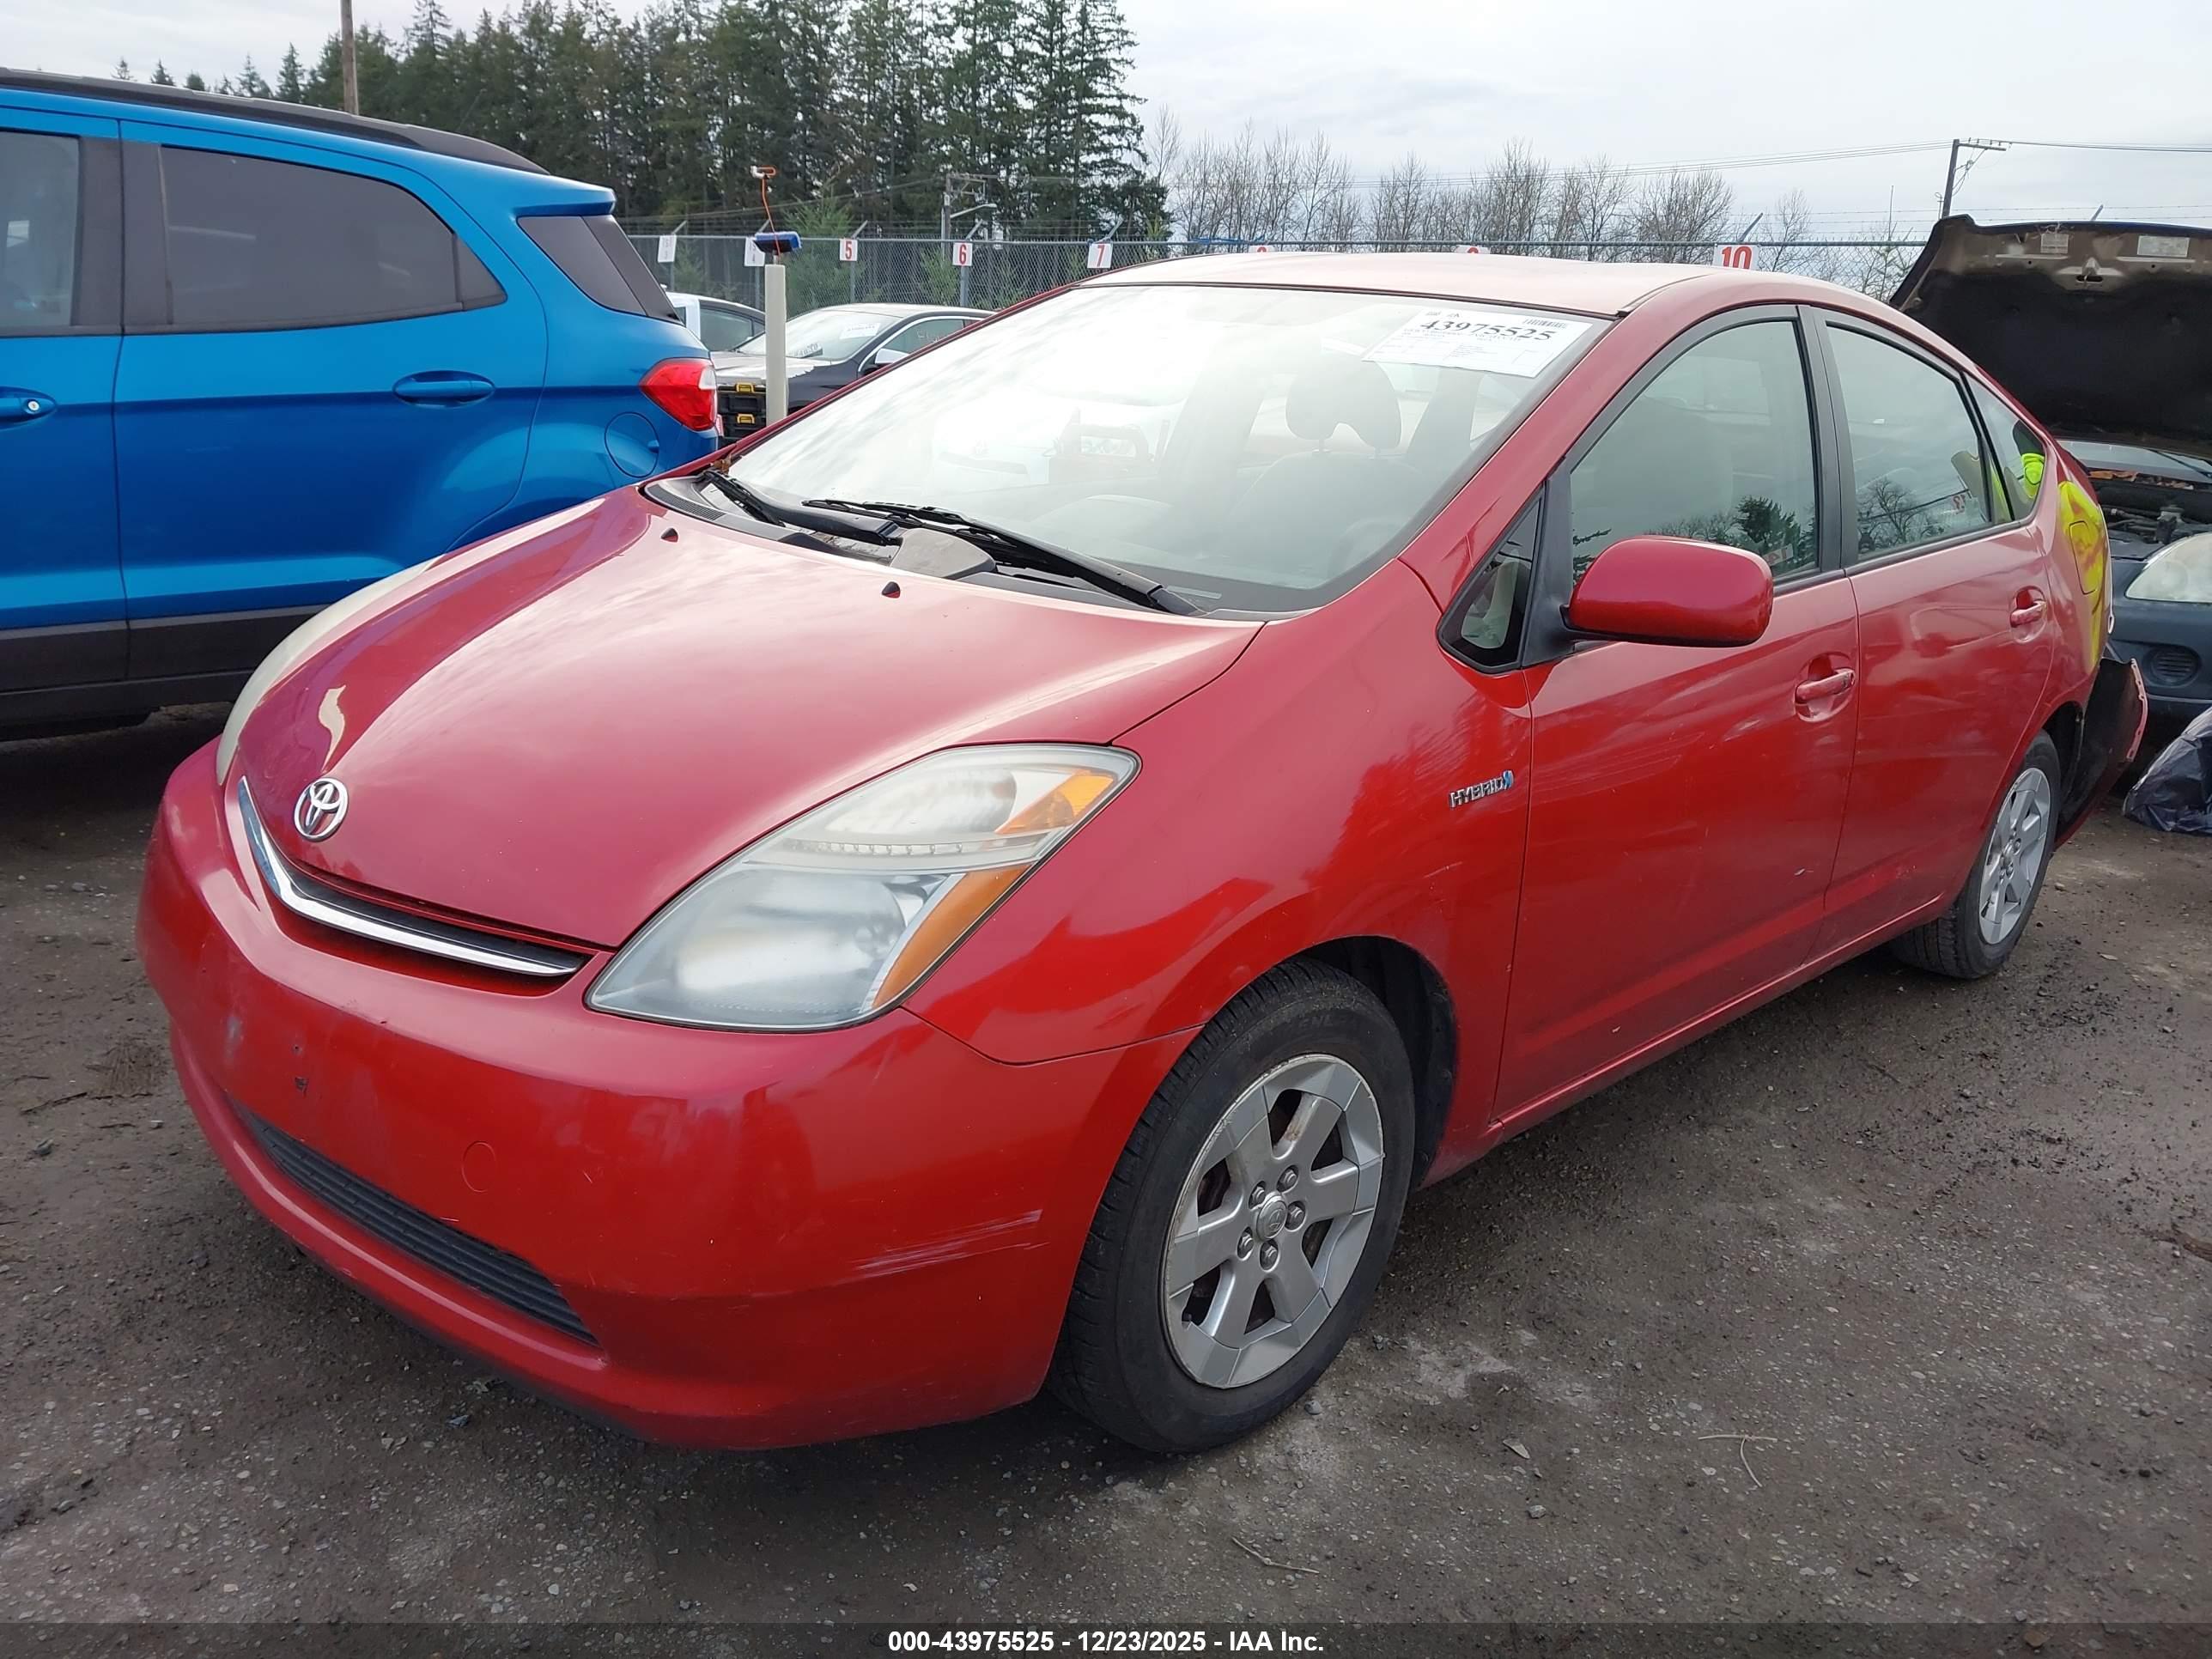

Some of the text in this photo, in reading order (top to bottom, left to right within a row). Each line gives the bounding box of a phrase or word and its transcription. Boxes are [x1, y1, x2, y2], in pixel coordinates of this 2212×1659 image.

[845, 240, 853, 259] 5
[958, 244, 967, 264] 6
[1097, 244, 1106, 267] 7
[1722, 246, 1753, 270] 10
[1419, 319, 1558, 342] 43975525
[1449, 776, 1504, 808] HYBRID
